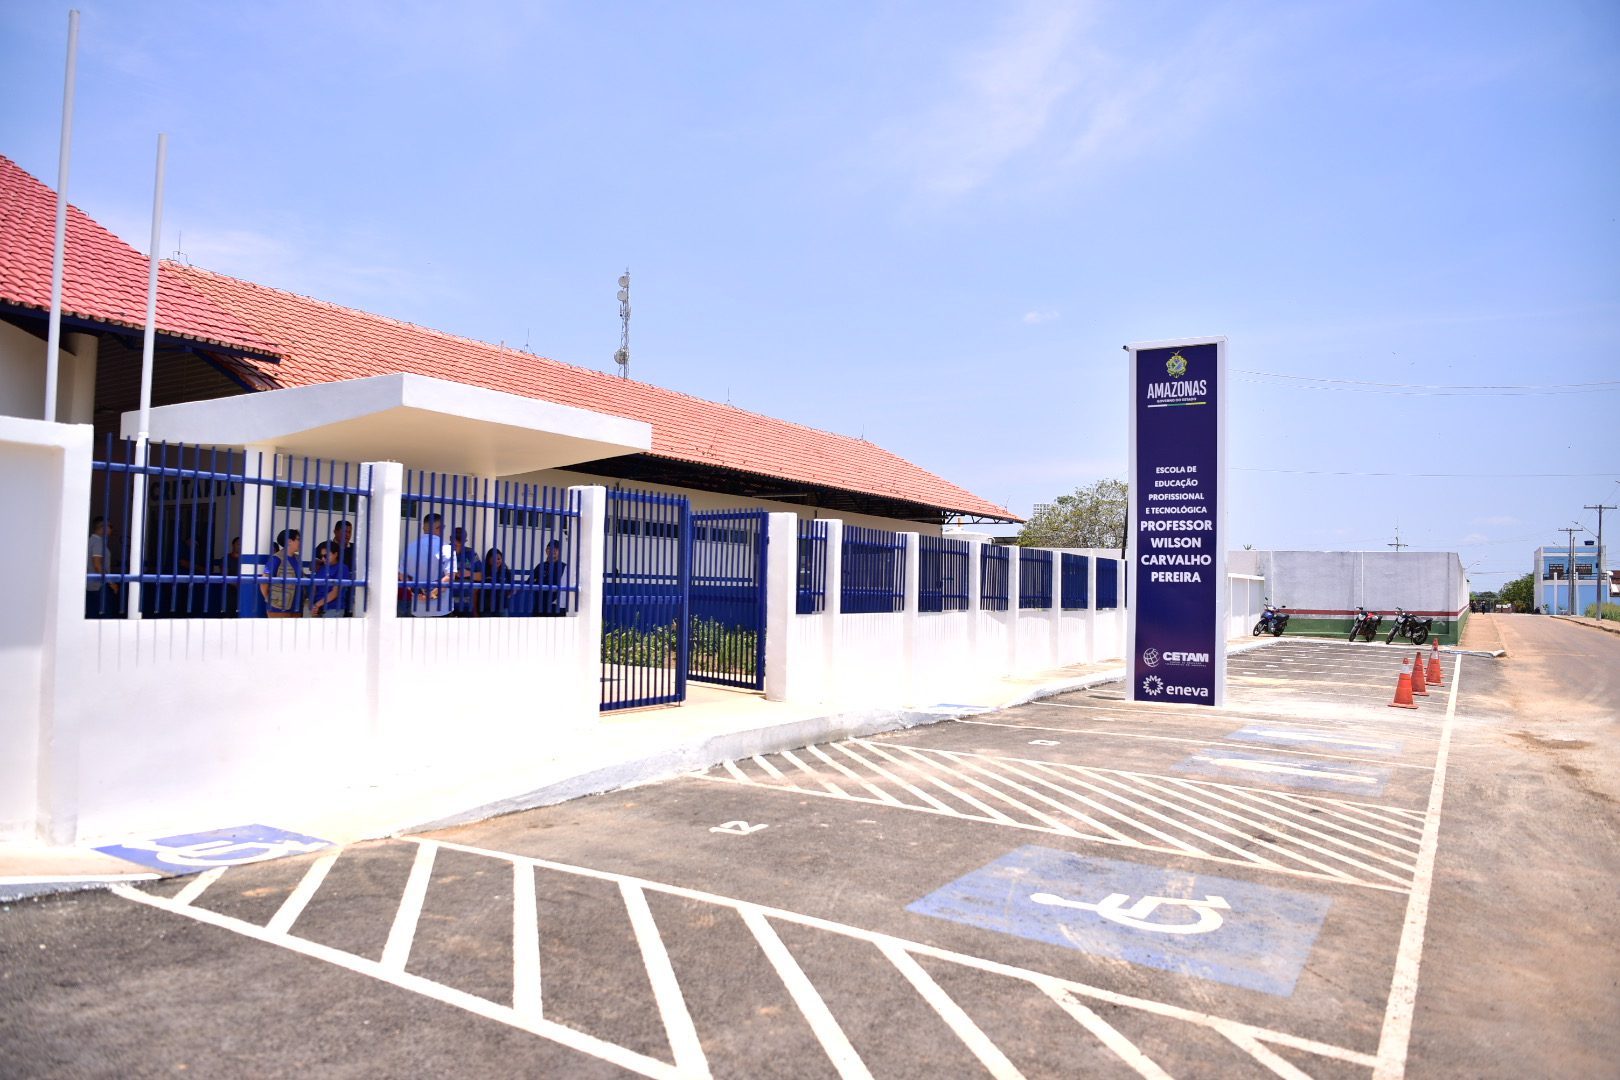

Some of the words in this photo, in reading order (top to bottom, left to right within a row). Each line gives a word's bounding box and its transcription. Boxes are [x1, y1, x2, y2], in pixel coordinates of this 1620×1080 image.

[1147, 380, 1207, 399] AMAZONAS
[1156, 466, 1185, 474] ESCOLA
[1154, 478, 1198, 488] EDUCAÇÃO
[1148, 493, 1205, 501] PROFISSIONAL
[1145, 507, 1150, 515] E
[1151, 505, 1207, 515] TECNOLÓGICA
[1140, 520, 1213, 532] PROFESSOR
[1150, 537, 1202, 548] WILSON
[1140, 554, 1212, 566] CARVALHO
[1151, 571, 1202, 583] PEREIRA
[1162, 651, 1209, 663] CETAM
[1166, 685, 1209, 697] eneva
